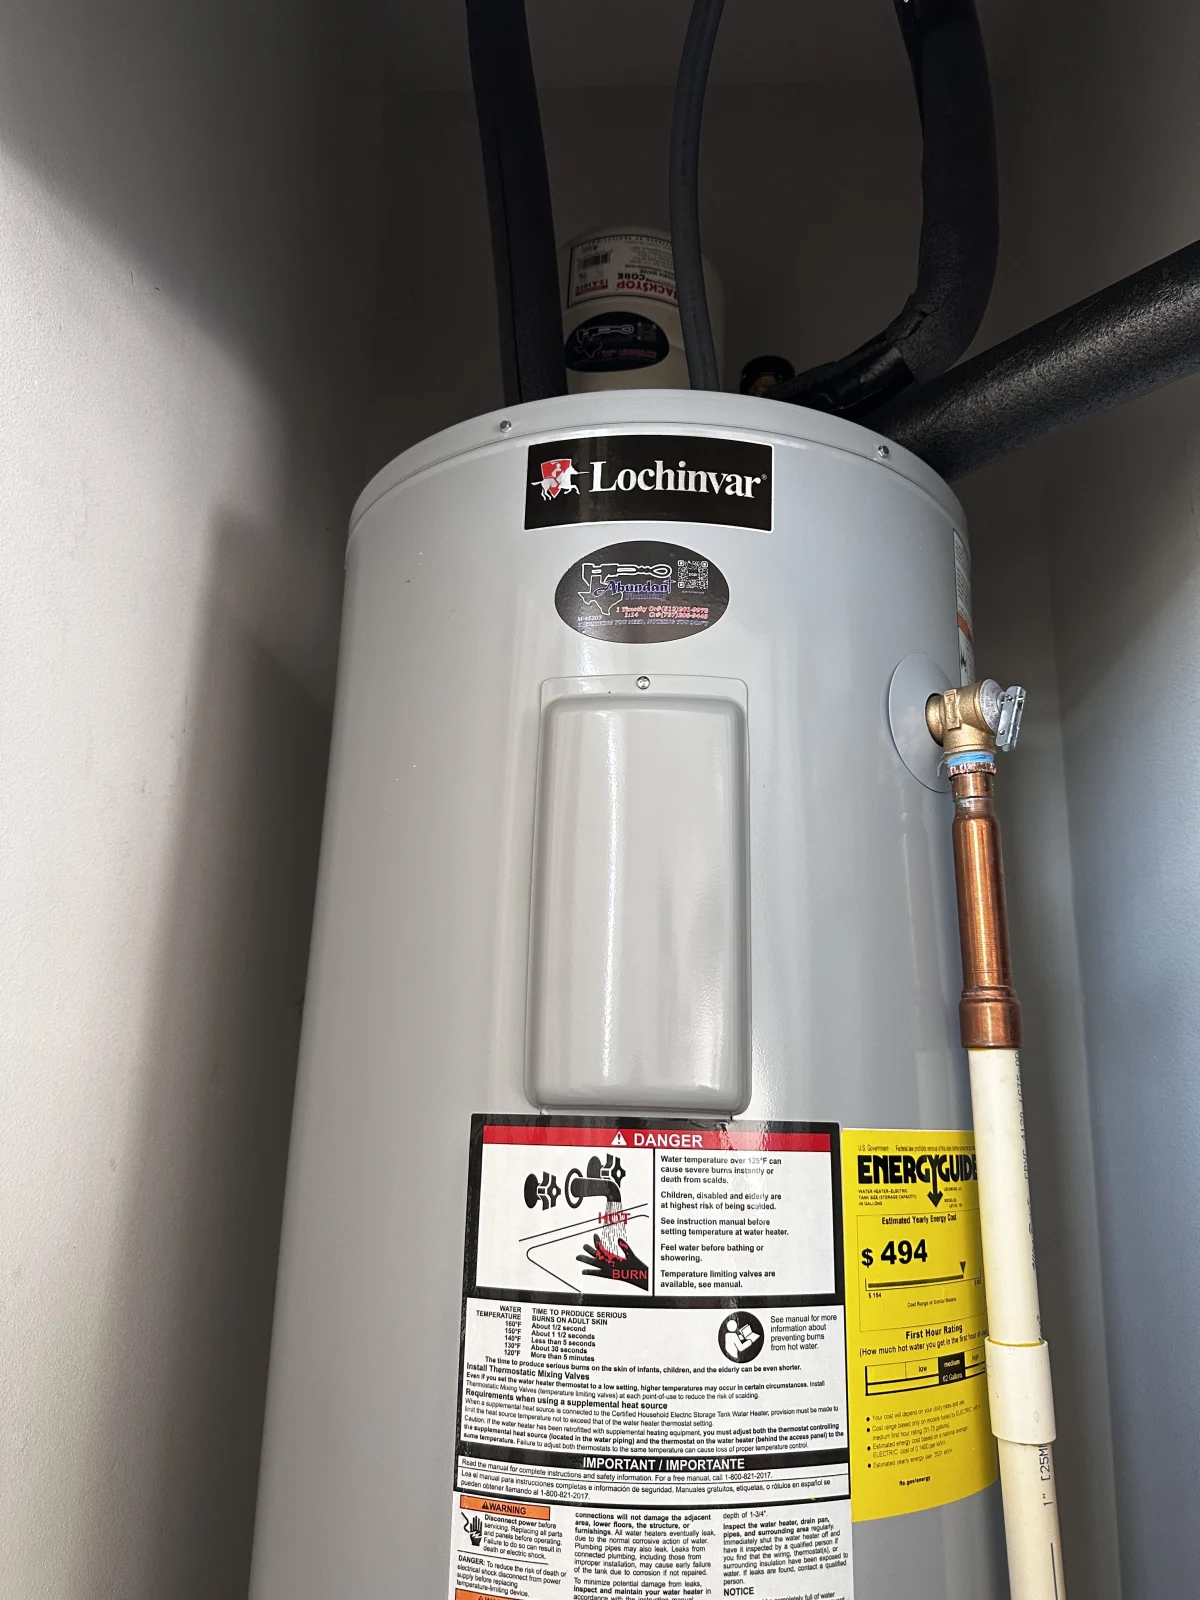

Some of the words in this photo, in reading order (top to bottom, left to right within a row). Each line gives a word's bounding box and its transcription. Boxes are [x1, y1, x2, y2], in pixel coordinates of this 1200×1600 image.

[589, 460, 761, 498] Lochinvar
[634, 1134, 702, 1147] DANGER
[734, 1167, 764, 1175] instantly
[661, 1191, 694, 1200] Children,
[670, 1202, 698, 1210] highest
[716, 1202, 723, 1210] of
[725, 1202, 745, 1211] being
[598, 1212, 630, 1224] HOT
[882, 1216, 910, 1225] Estimated
[912, 1216, 928, 1224] Yearly
[930, 1215, 946, 1223] Energy
[661, 1228, 686, 1236] setting
[862, 1248, 873, 1267] $
[881, 1239, 927, 1264] 494
[661, 1254, 702, 1262] showering.
[612, 1270, 647, 1279] BURN
[661, 1270, 708, 1278] Temperature
[500, 1305, 521, 1313] WATER
[477, 1310, 521, 1320] TEMPERATURE
[771, 1324, 806, 1332] information
[906, 1331, 923, 1339] First
[926, 1328, 942, 1337] Hour
[944, 1324, 962, 1334] Rating
[568, 1332, 595, 1340] seconds
[771, 1334, 805, 1342] preventing
[771, 1343, 785, 1351] from
[860, 1348, 876, 1357] (How
[879, 1346, 896, 1354] much
[926, 1341, 935, 1349] you
[937, 1340, 945, 1348] get
[569, 1354, 594, 1362] minutes
[467, 1362, 487, 1371] Install
[489, 1365, 536, 1376] Thermostatic
[538, 1369, 562, 1380] Mixing
[565, 1371, 589, 1380] Valves
[466, 1388, 513, 1401] Requirements
[516, 1394, 535, 1402] when
[538, 1395, 558, 1406] using
[568, 1398, 619, 1410] supplemental
[583, 1457, 656, 1470] IMPORTANT
[658, 1459, 663, 1470] /
[666, 1458, 745, 1470] IMPORTANTE
[725, 1472, 773, 1480] 1-800-821-2017.
[490, 1504, 526, 1514] WARNING
[485, 1514, 517, 1524] Disconnect
[519, 1520, 537, 1529] power
[724, 1587, 754, 1596] NOTICE
